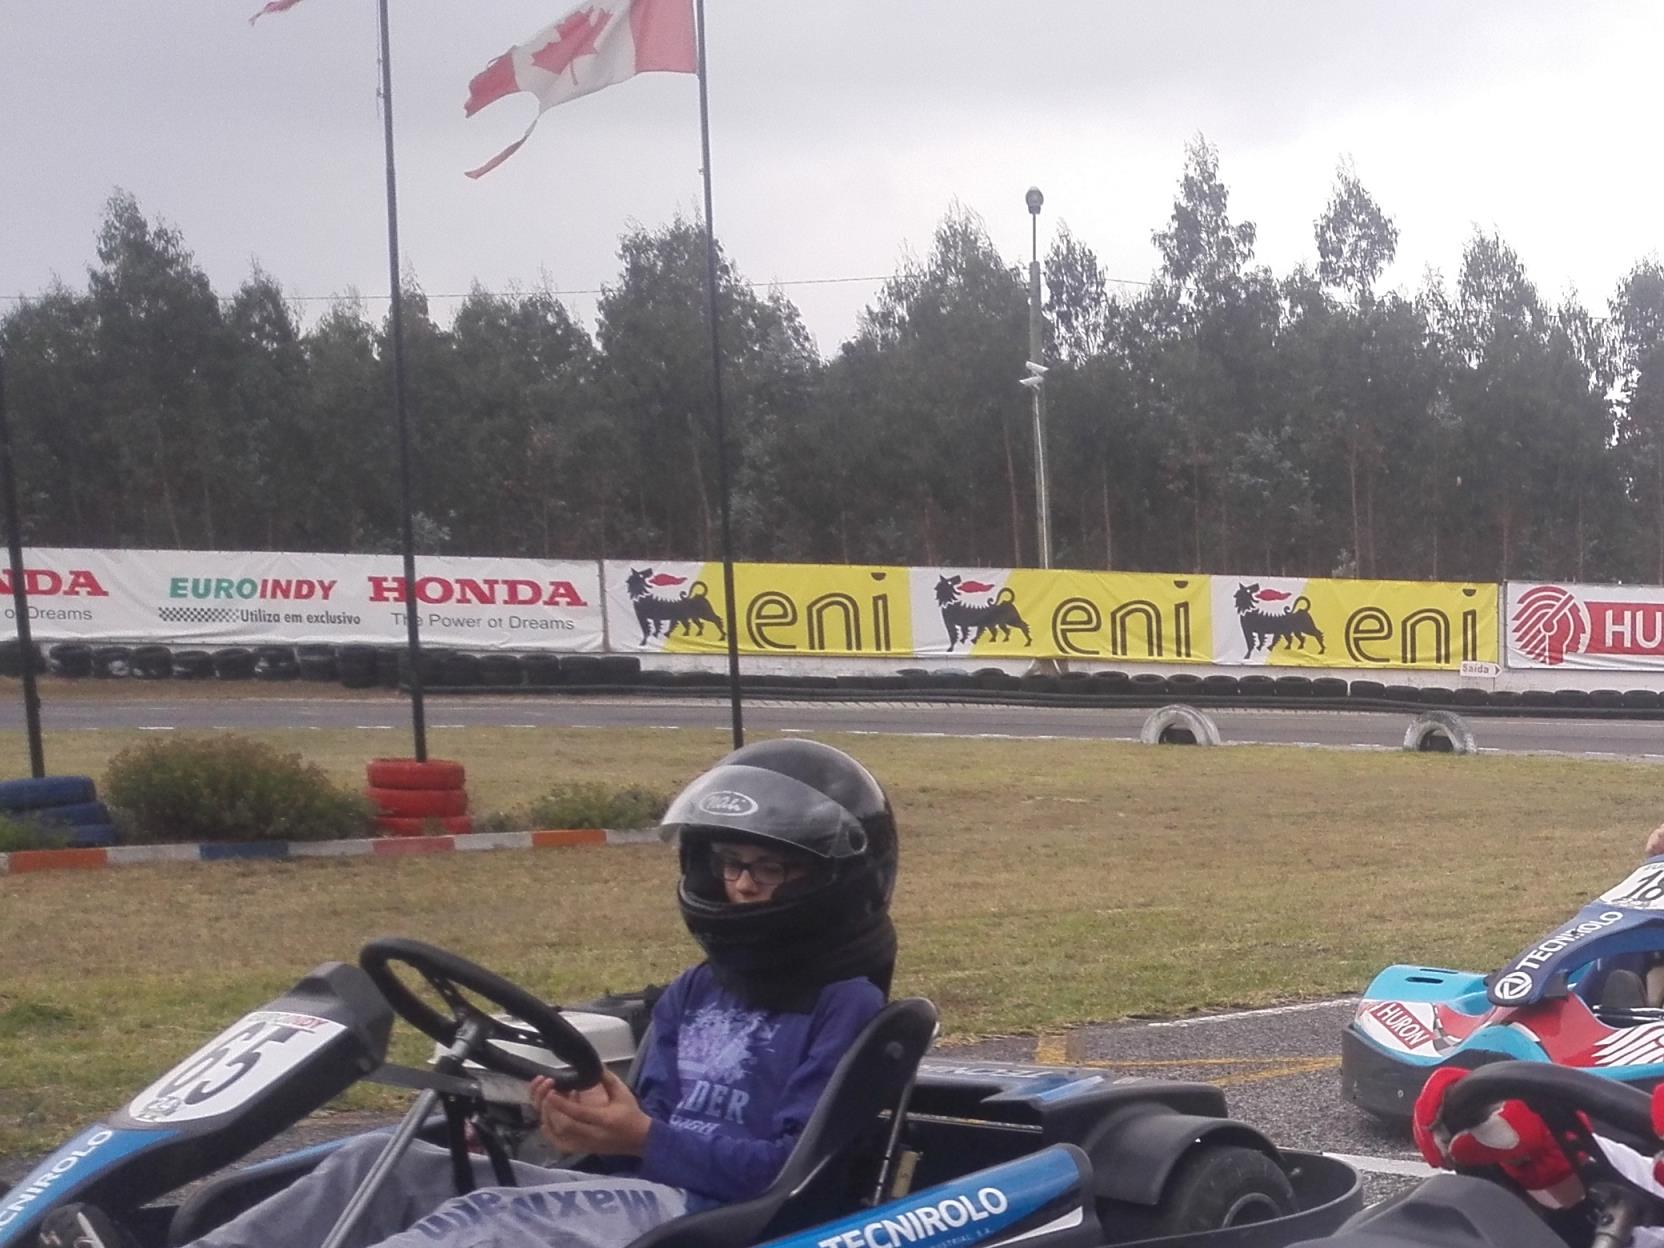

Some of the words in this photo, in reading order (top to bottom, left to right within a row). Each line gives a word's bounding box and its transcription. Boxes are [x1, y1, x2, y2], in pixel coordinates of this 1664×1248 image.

[169, 577, 337, 600] EUROINDY
[367, 576, 587, 606] HONDA
[27, 606, 93, 621] Dreams
[240, 610, 280, 623] Utiliza
[284, 613, 302, 623] em
[306, 611, 361, 625] exclusivo
[429, 613, 481, 628] Power
[487, 613, 502, 628] of
[509, 615, 575, 630] Dreams
[746, 571, 892, 653] eni
[1051, 579, 1192, 659] eni
[1344, 587, 1478, 664] eni
[1377, 1002, 1430, 1047] HURON
[156, 1022, 301, 1105] 65
